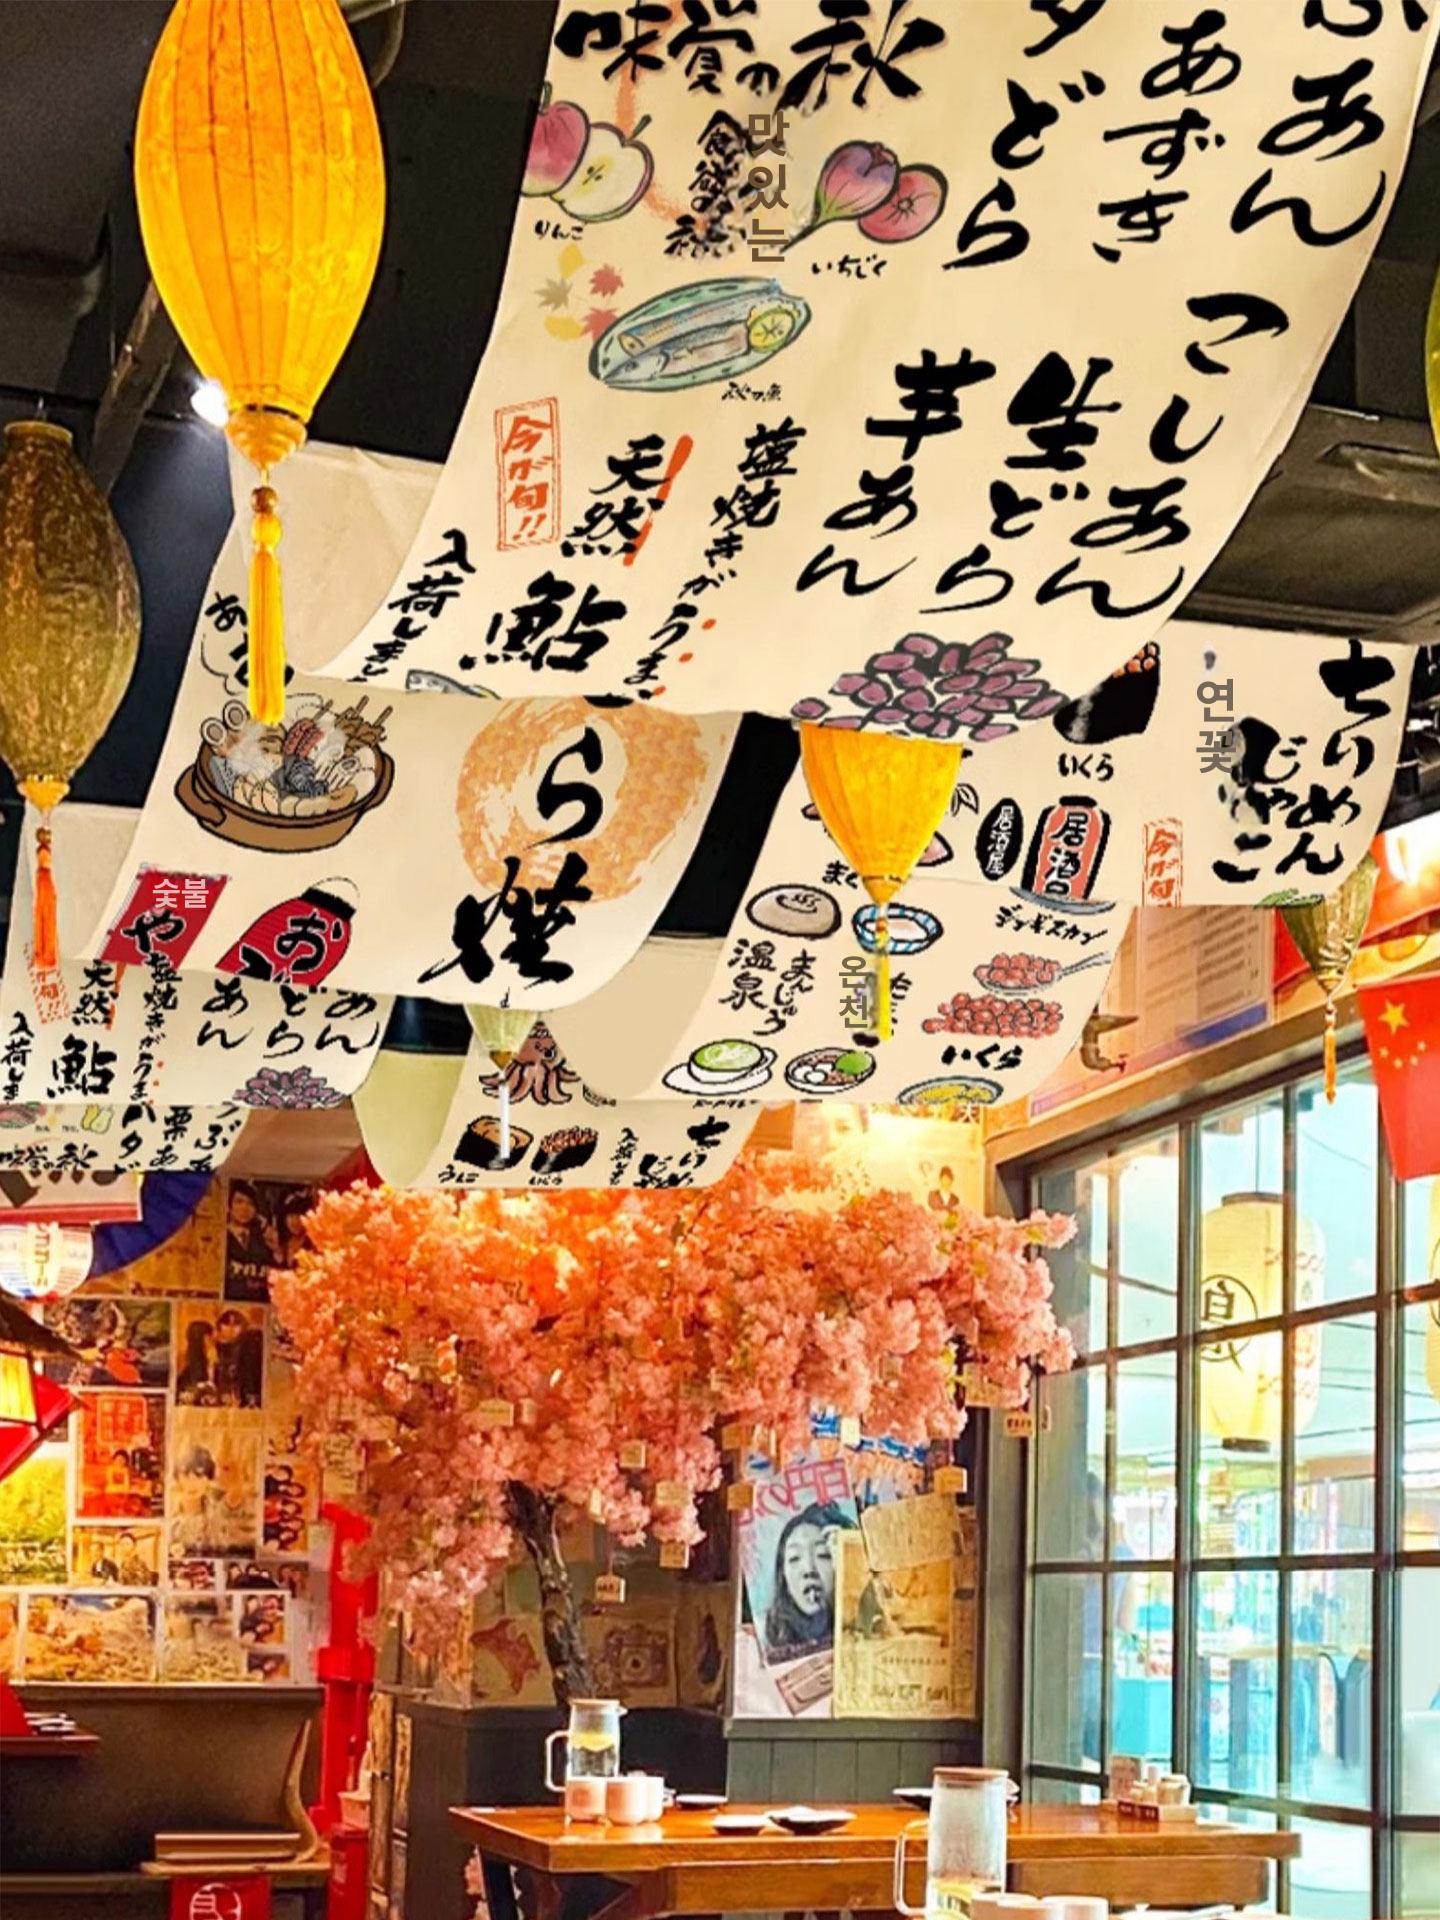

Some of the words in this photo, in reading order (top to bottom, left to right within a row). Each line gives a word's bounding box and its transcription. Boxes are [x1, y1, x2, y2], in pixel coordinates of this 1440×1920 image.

[1093, 10, 1241, 263] あずき
[812, 254, 887, 278] いちじく
[1036, 293, 1289, 618] こしあん
[561, 434, 667, 557] 天然
[459, 571, 627, 672] 鮎
[1058, 753, 1114, 782] いくら
[727, 938, 776, 1012] 温泉
[47, 1033, 117, 1098] 鮎
[941, 1044, 1023, 1072] いくら
